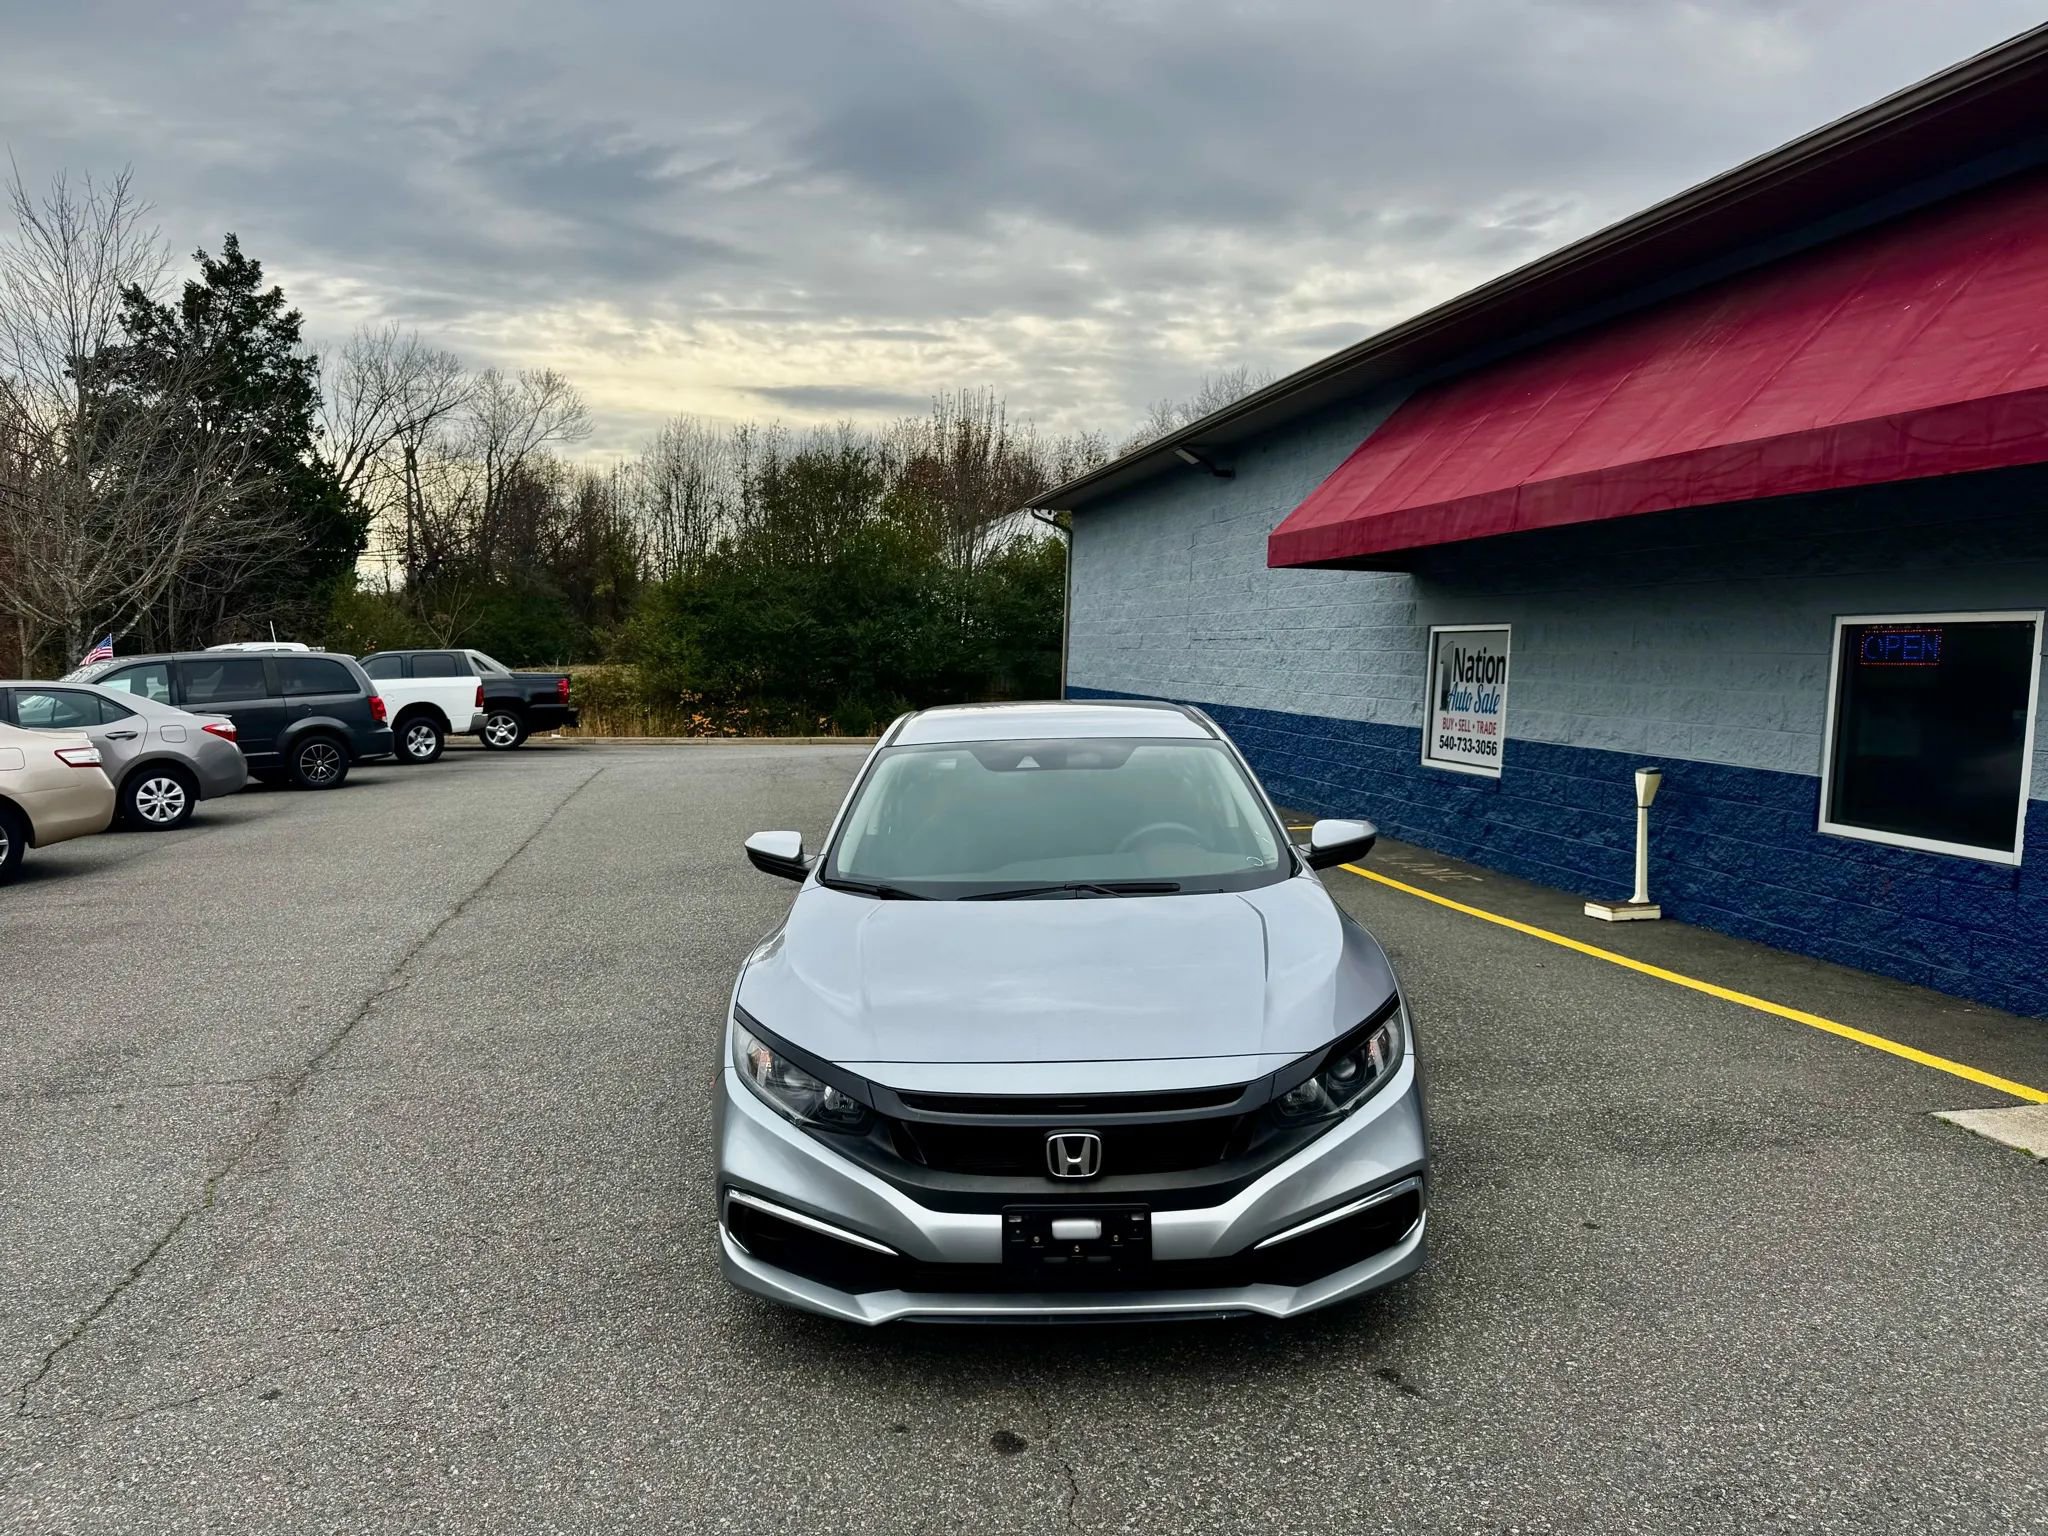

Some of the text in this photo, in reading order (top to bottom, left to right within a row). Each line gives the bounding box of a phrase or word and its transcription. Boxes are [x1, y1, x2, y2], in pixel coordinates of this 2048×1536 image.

[1863, 634, 1939, 660] OPEN
[1453, 647, 1505, 684] Nation
[1448, 682, 1500, 714] Auto Sale
[1442, 717, 1497, 735] BUY SELL TRADE
[1439, 735, 1497, 756] 540-733-3056
